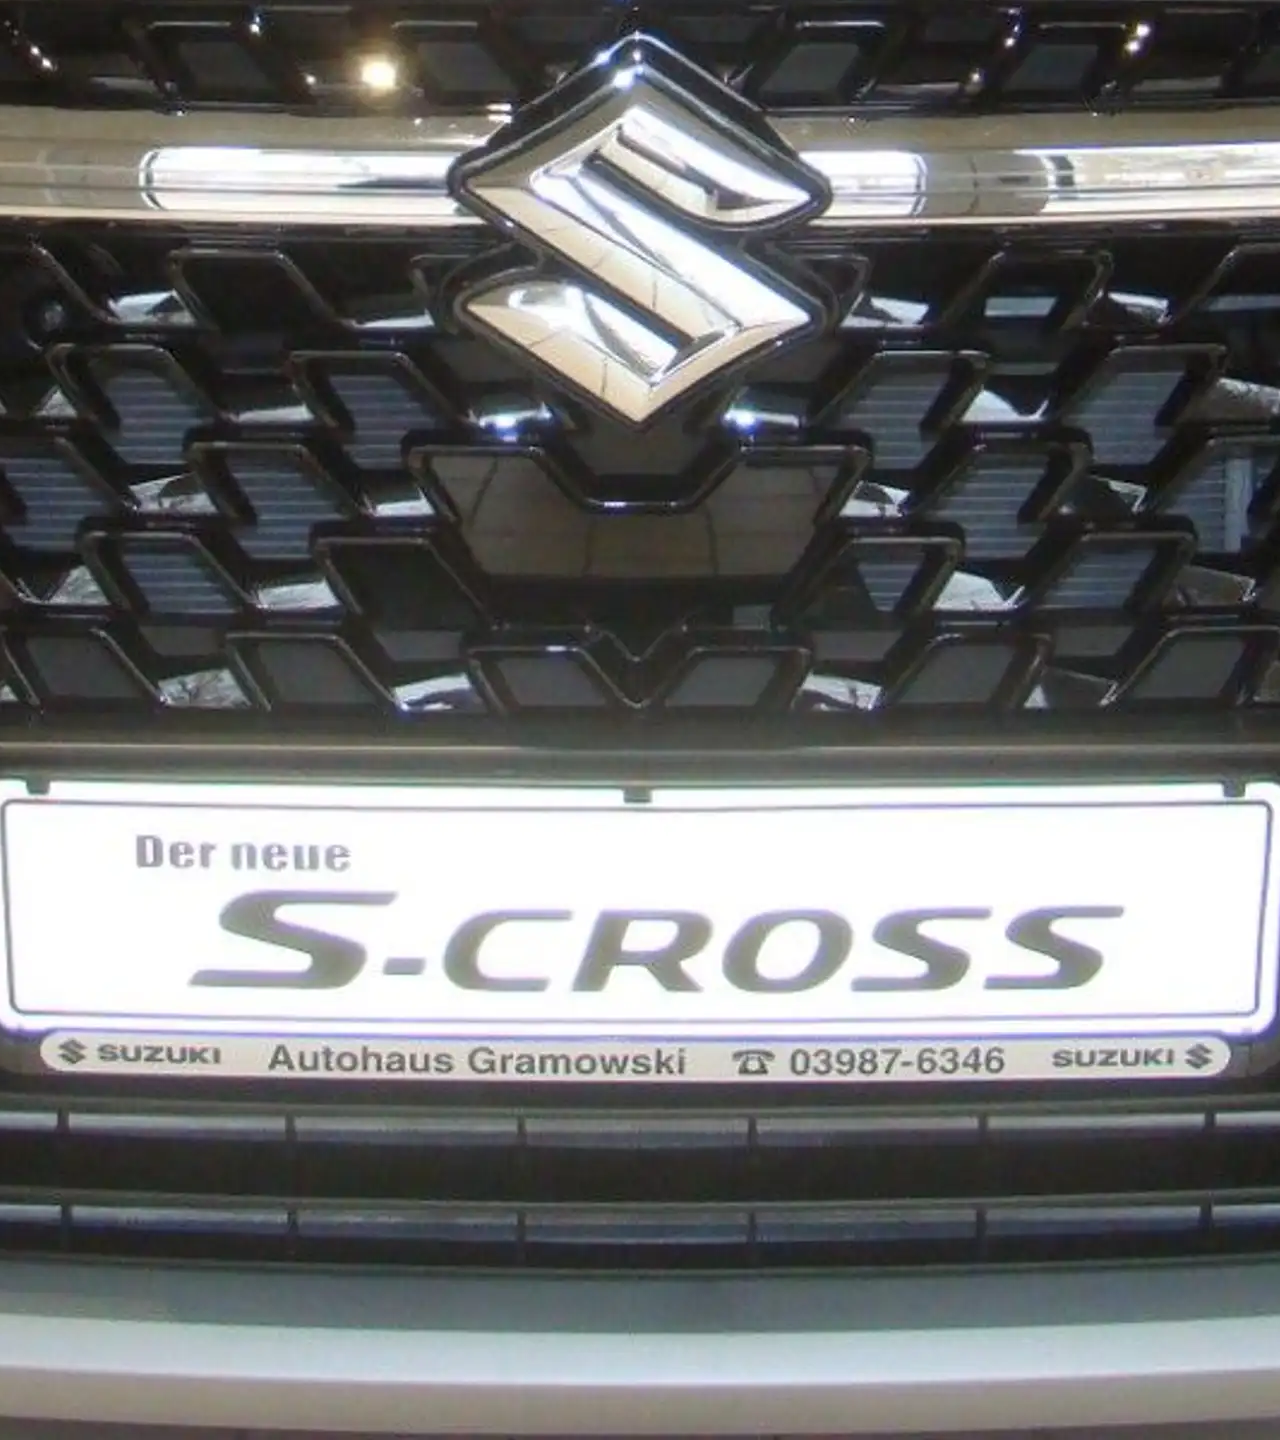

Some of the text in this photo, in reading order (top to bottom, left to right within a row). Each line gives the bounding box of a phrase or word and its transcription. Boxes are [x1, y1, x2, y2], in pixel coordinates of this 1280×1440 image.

[135, 834, 352, 872] Der neue
[188, 889, 1125, 994] S-CROSS
[96, 1043, 1175, 1076] SUZUKI Autohaus Gramowski 03987-6346 SUZUKI
